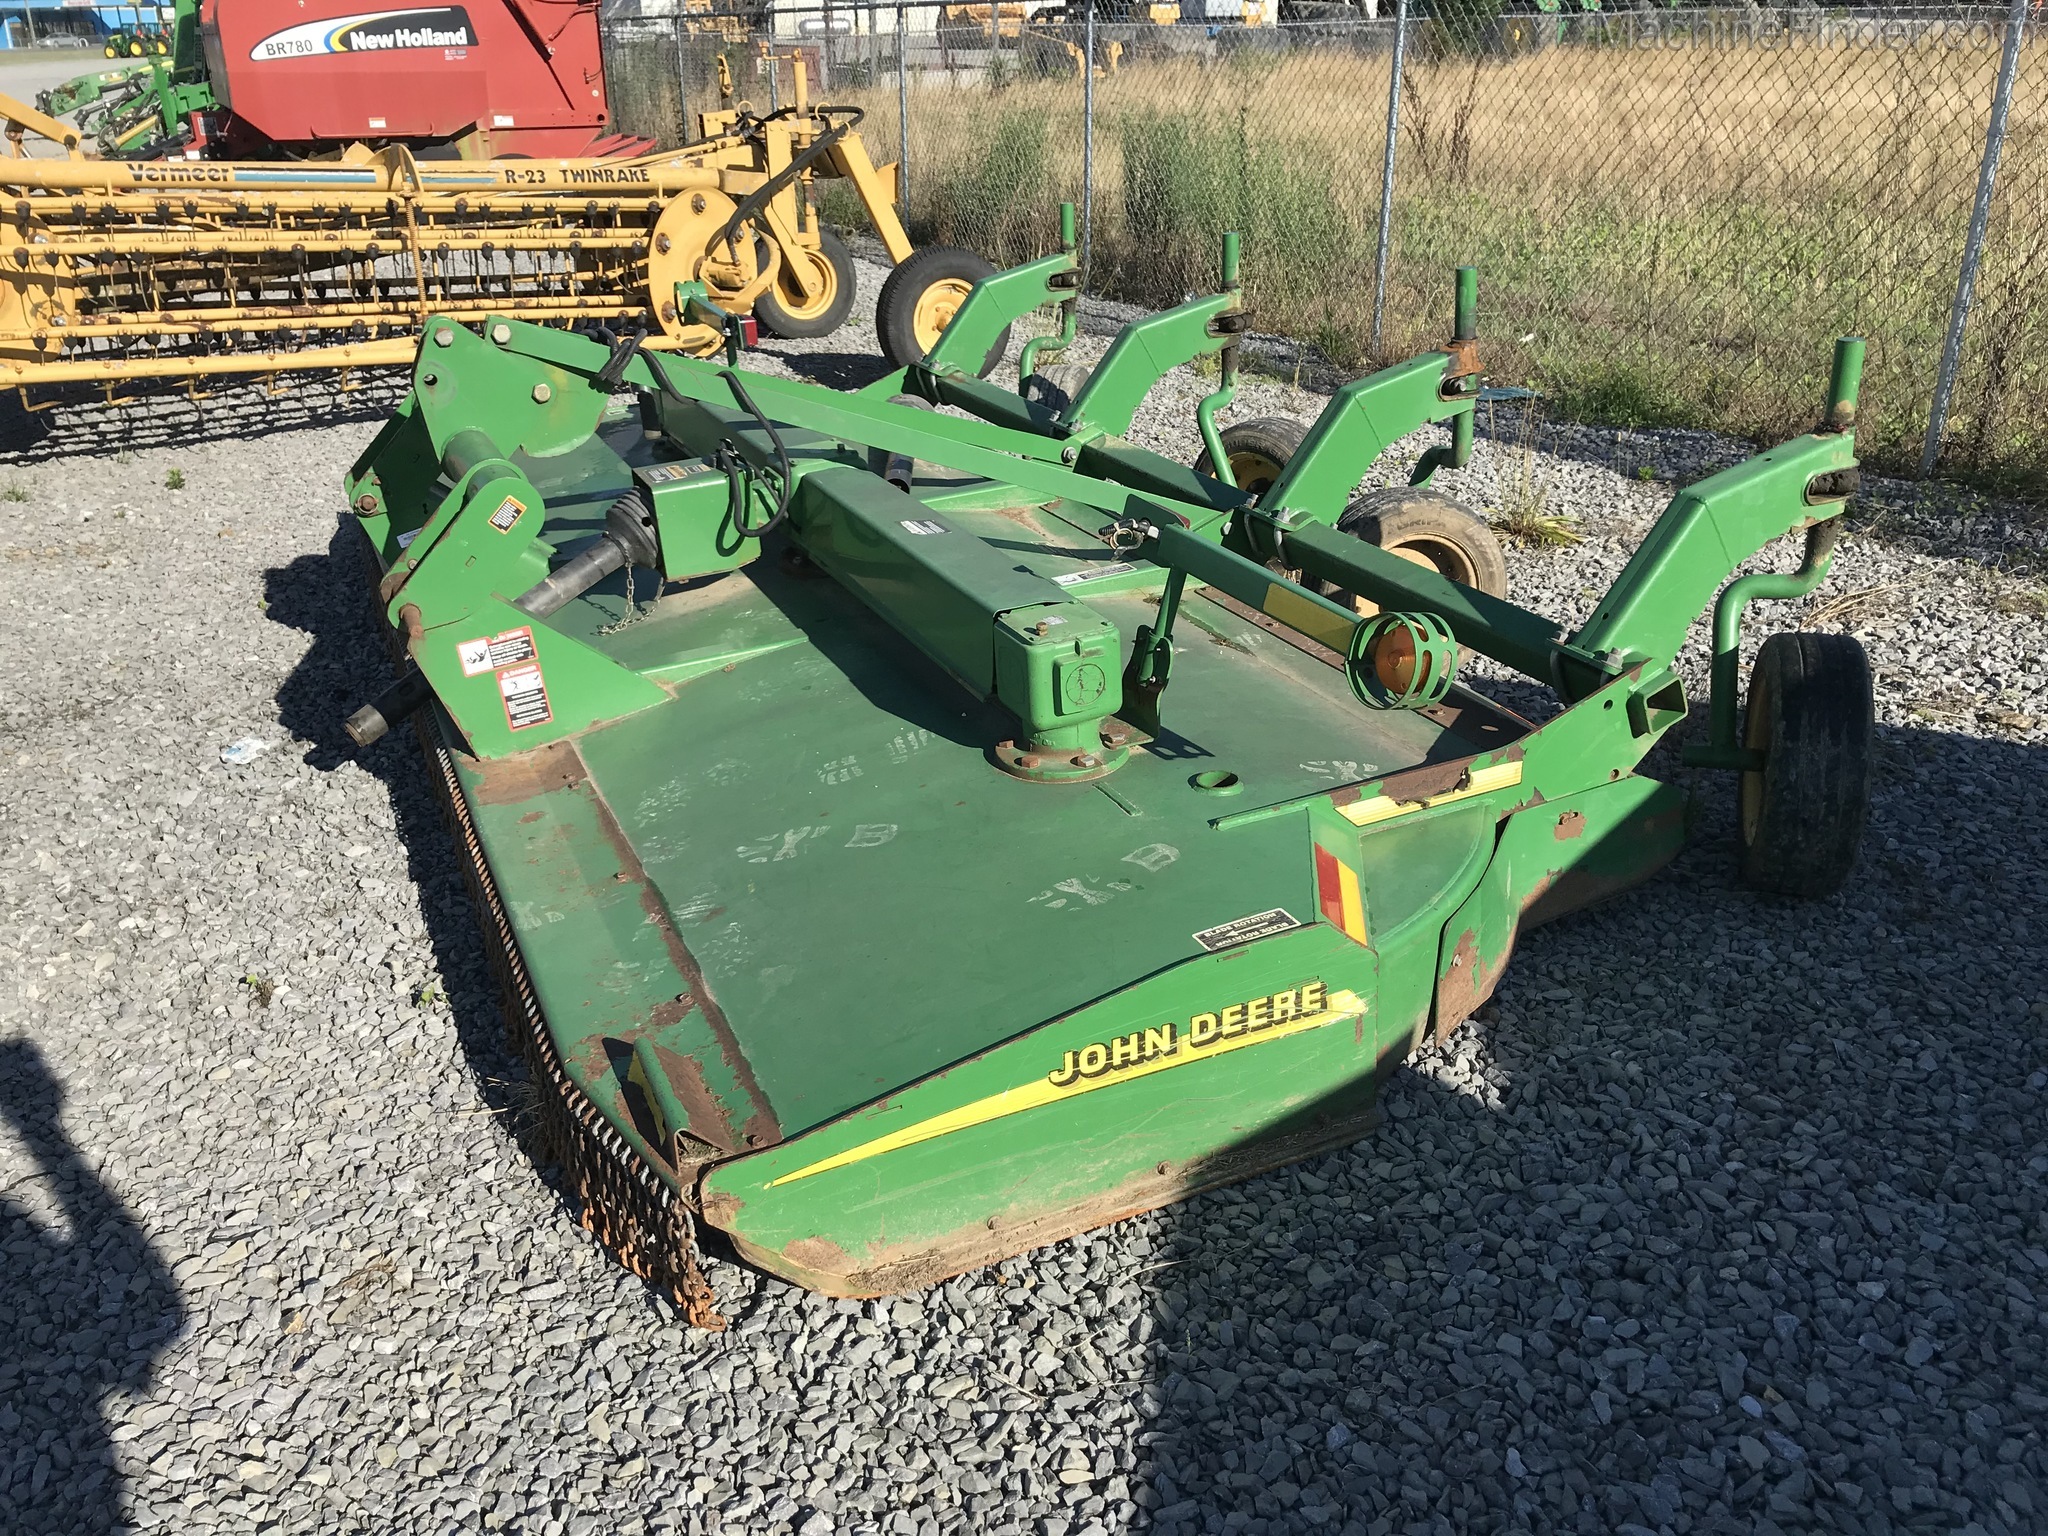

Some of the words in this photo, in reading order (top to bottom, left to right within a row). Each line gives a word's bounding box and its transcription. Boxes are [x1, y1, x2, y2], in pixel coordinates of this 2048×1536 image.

[265, 39, 313, 56] BR780
[350, 31, 394, 50] New
[395, 27, 468, 48] Holland
[126, 163, 229, 182] Vermeer
[504, 169, 546, 184] R-23
[559, 168, 650, 183] TWINRAKE
[1204, 925, 1233, 938] BLADE
[1234, 912, 1277, 929] ROTATION
[1048, 1022, 1178, 1087] JOHN
[1190, 980, 1329, 1048] DEERE
